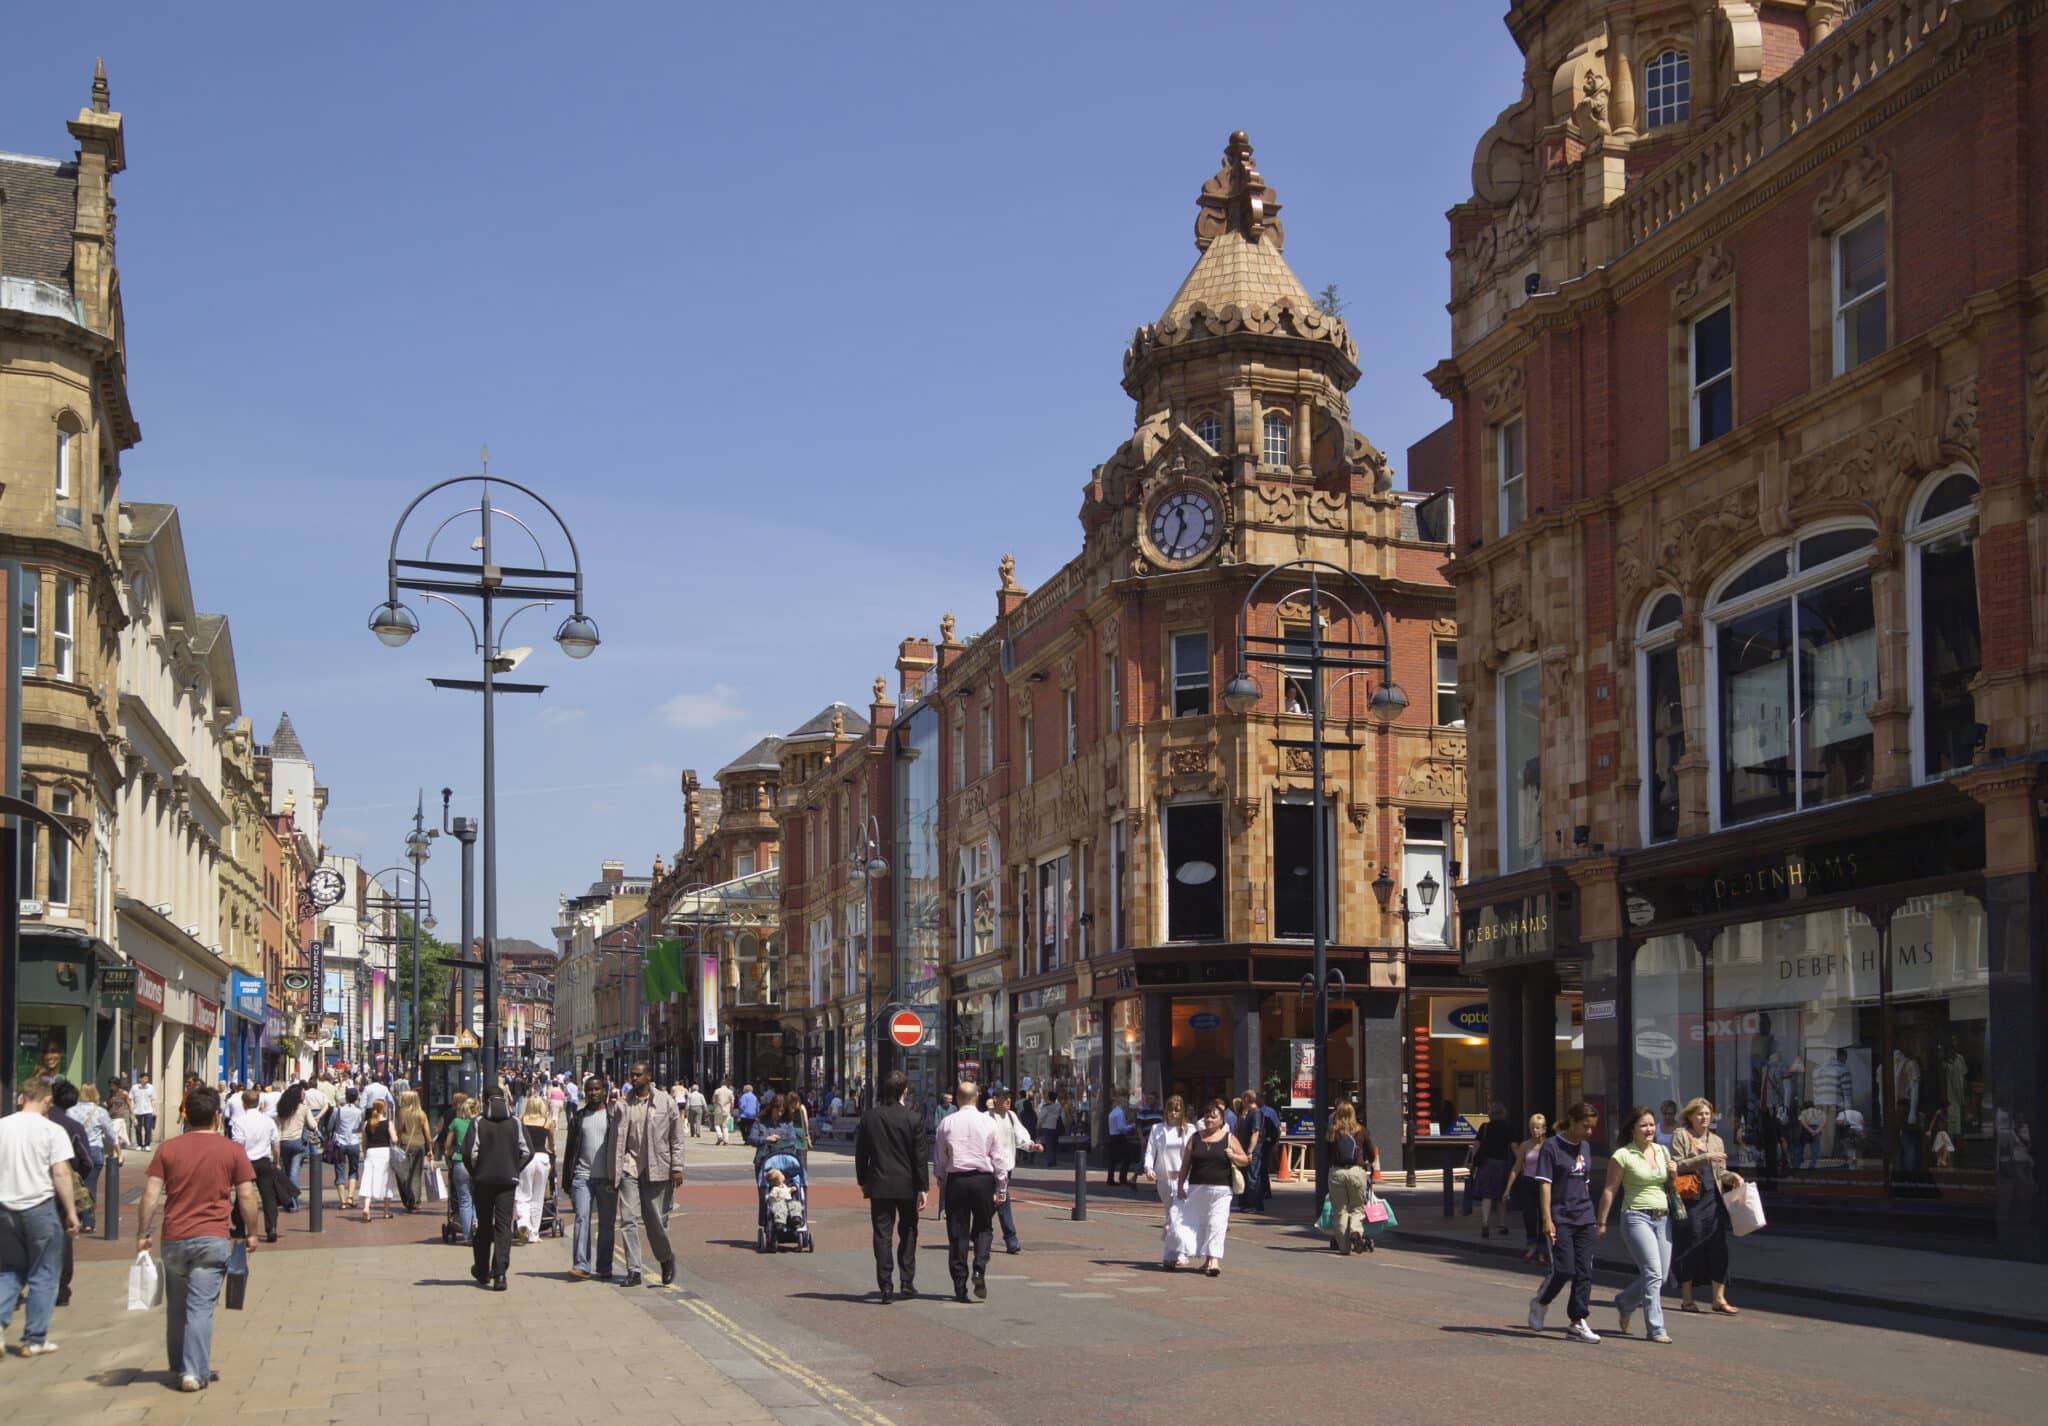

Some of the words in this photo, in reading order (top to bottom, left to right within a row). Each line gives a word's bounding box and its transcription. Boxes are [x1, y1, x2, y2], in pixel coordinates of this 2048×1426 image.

[1467, 914, 1548, 944] DEBENHAMS
[1779, 942, 1934, 980] DEBENHMS
[312, 979, 320, 1012] ARCADE
[1295, 1080, 1312, 1089] FREE
